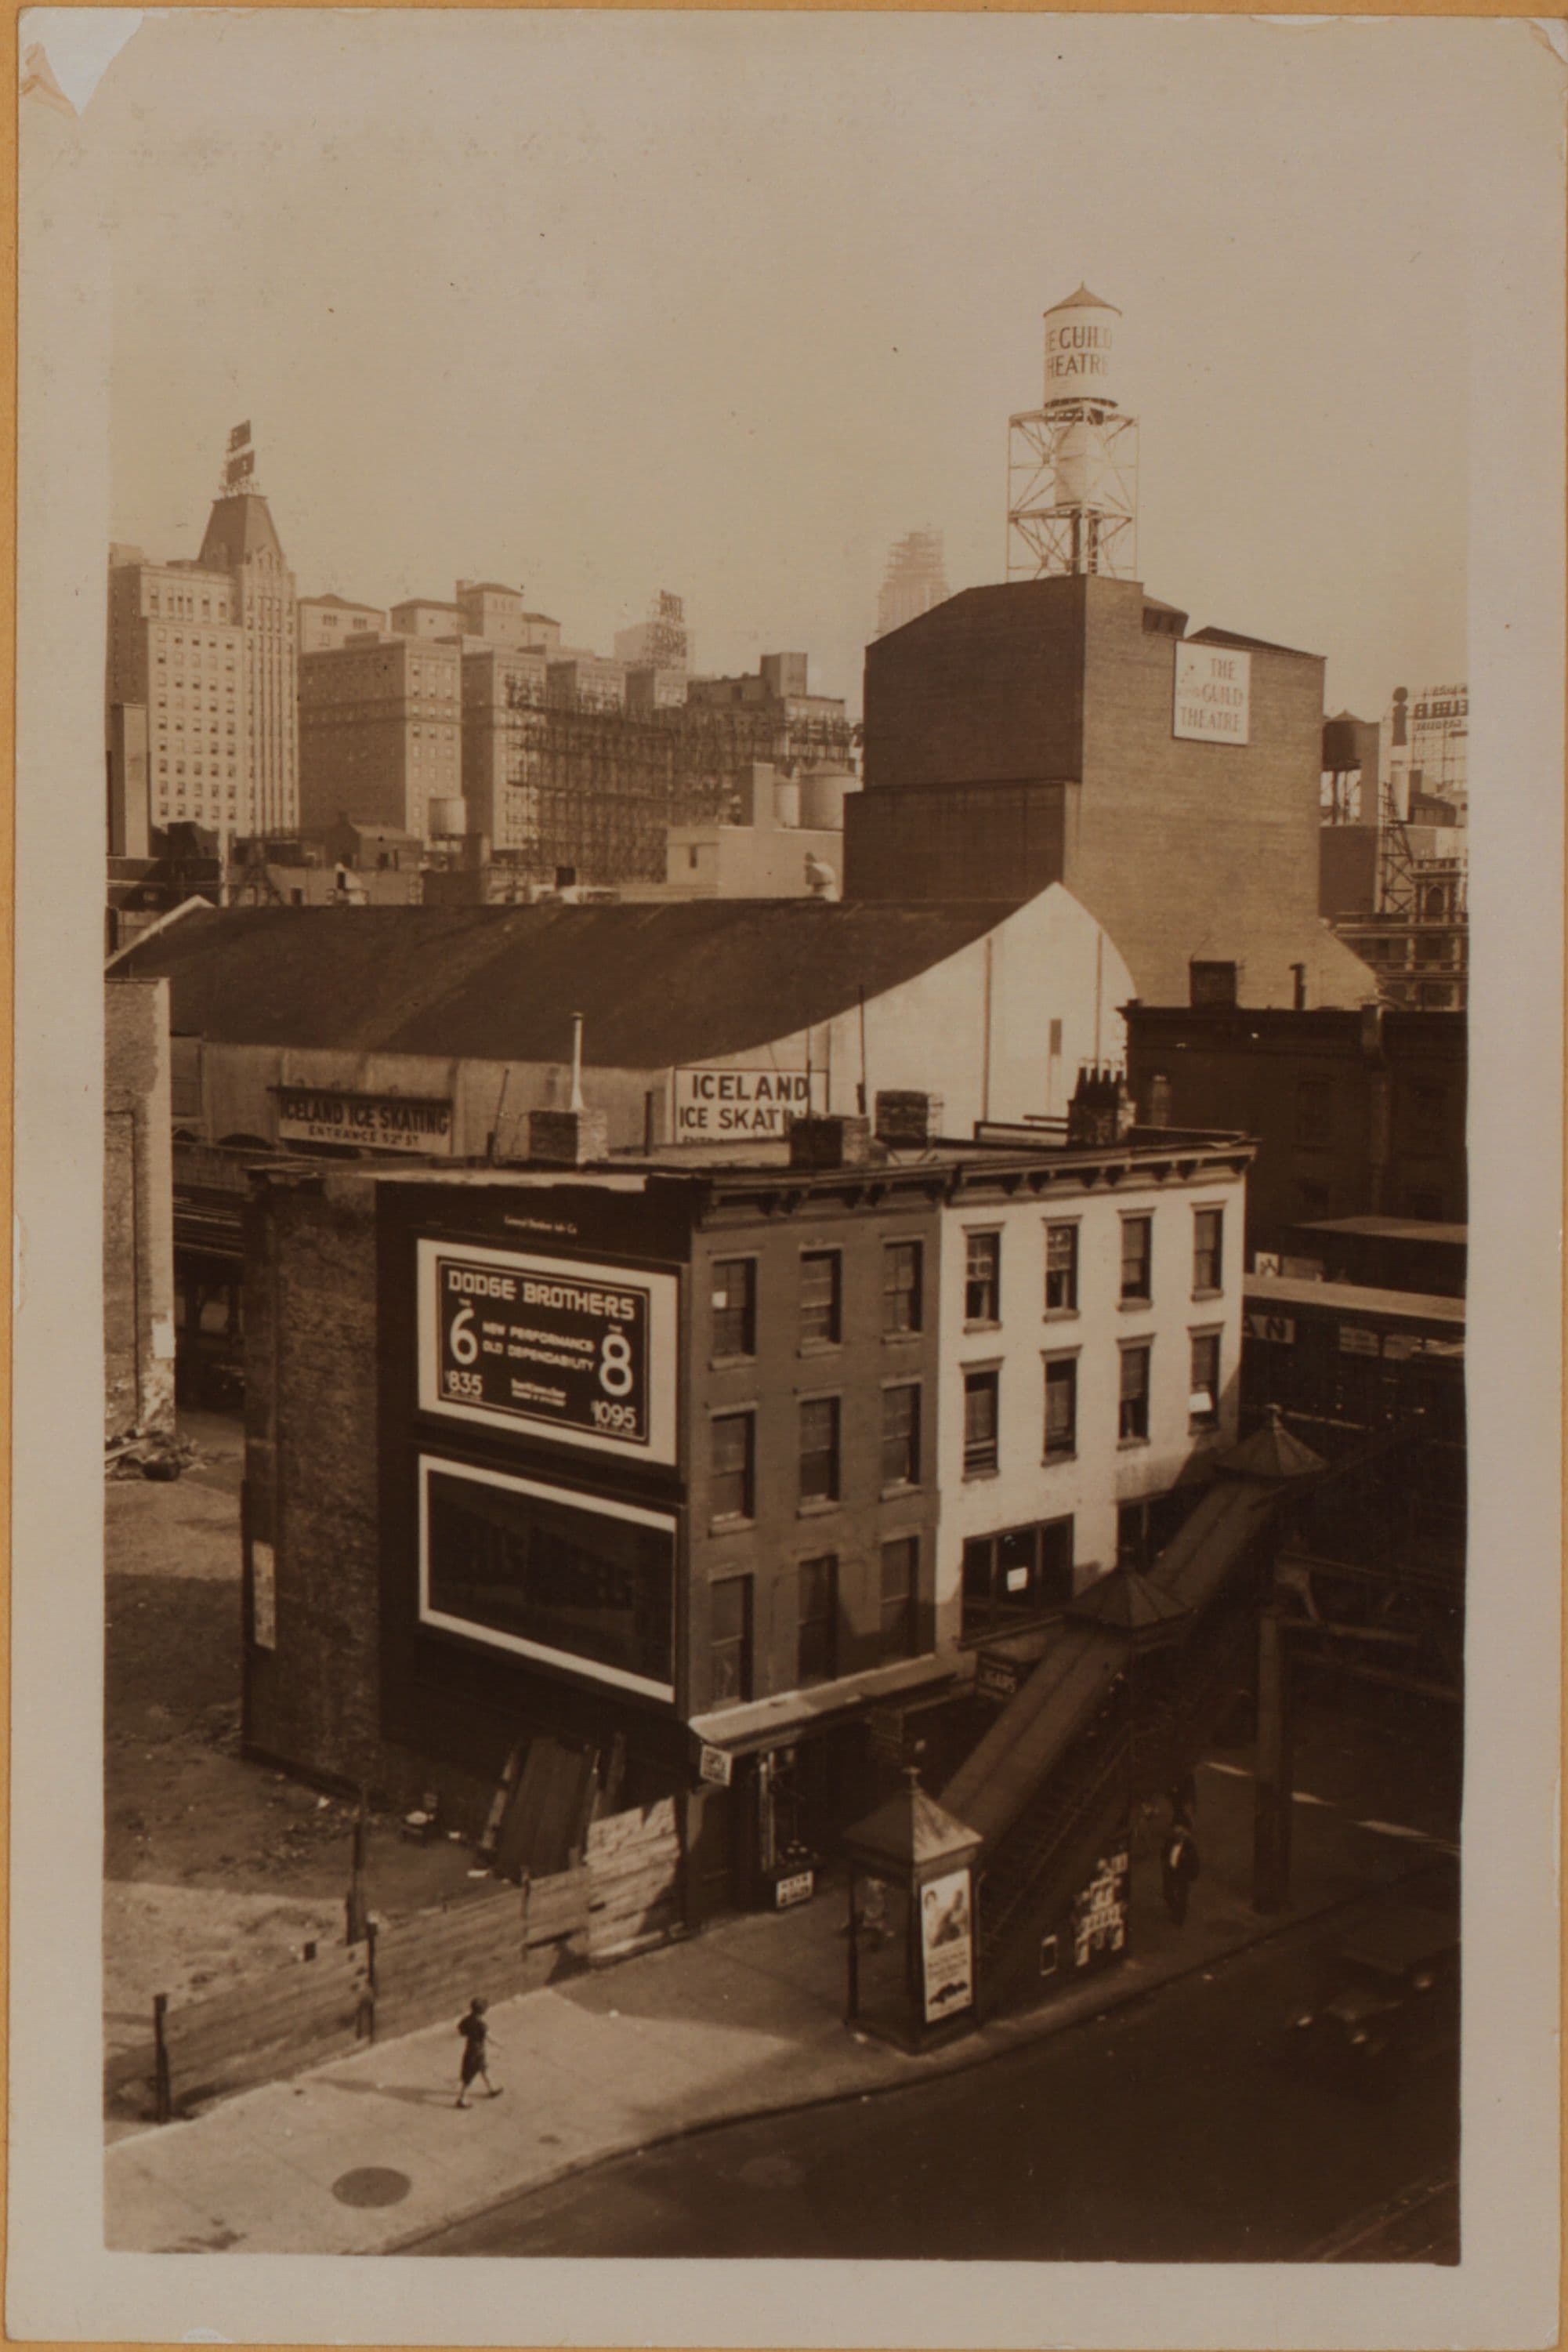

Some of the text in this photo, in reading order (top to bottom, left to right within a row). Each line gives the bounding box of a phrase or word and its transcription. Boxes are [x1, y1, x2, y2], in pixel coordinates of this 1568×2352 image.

[1059, 326, 1112, 350] GUILD
[1047, 353, 1109, 380] HEATRE
[1179, 707, 1241, 732] THEATRE
[693, 1075, 809, 1100] ICELAND
[280, 1097, 449, 1135] ICELAND ICE SKATING
[679, 1107, 708, 1128] ICE
[308, 1125, 376, 1143] ENTRANCE
[447, 1270, 635, 1320] DODGE BROTHERS
[450, 1307, 478, 1366] 6
[509, 1326, 595, 1354] PERFORMANCE
[482, 1340, 595, 1372] OLD DEPENDABILITY
[599, 1334, 633, 1397] 8
